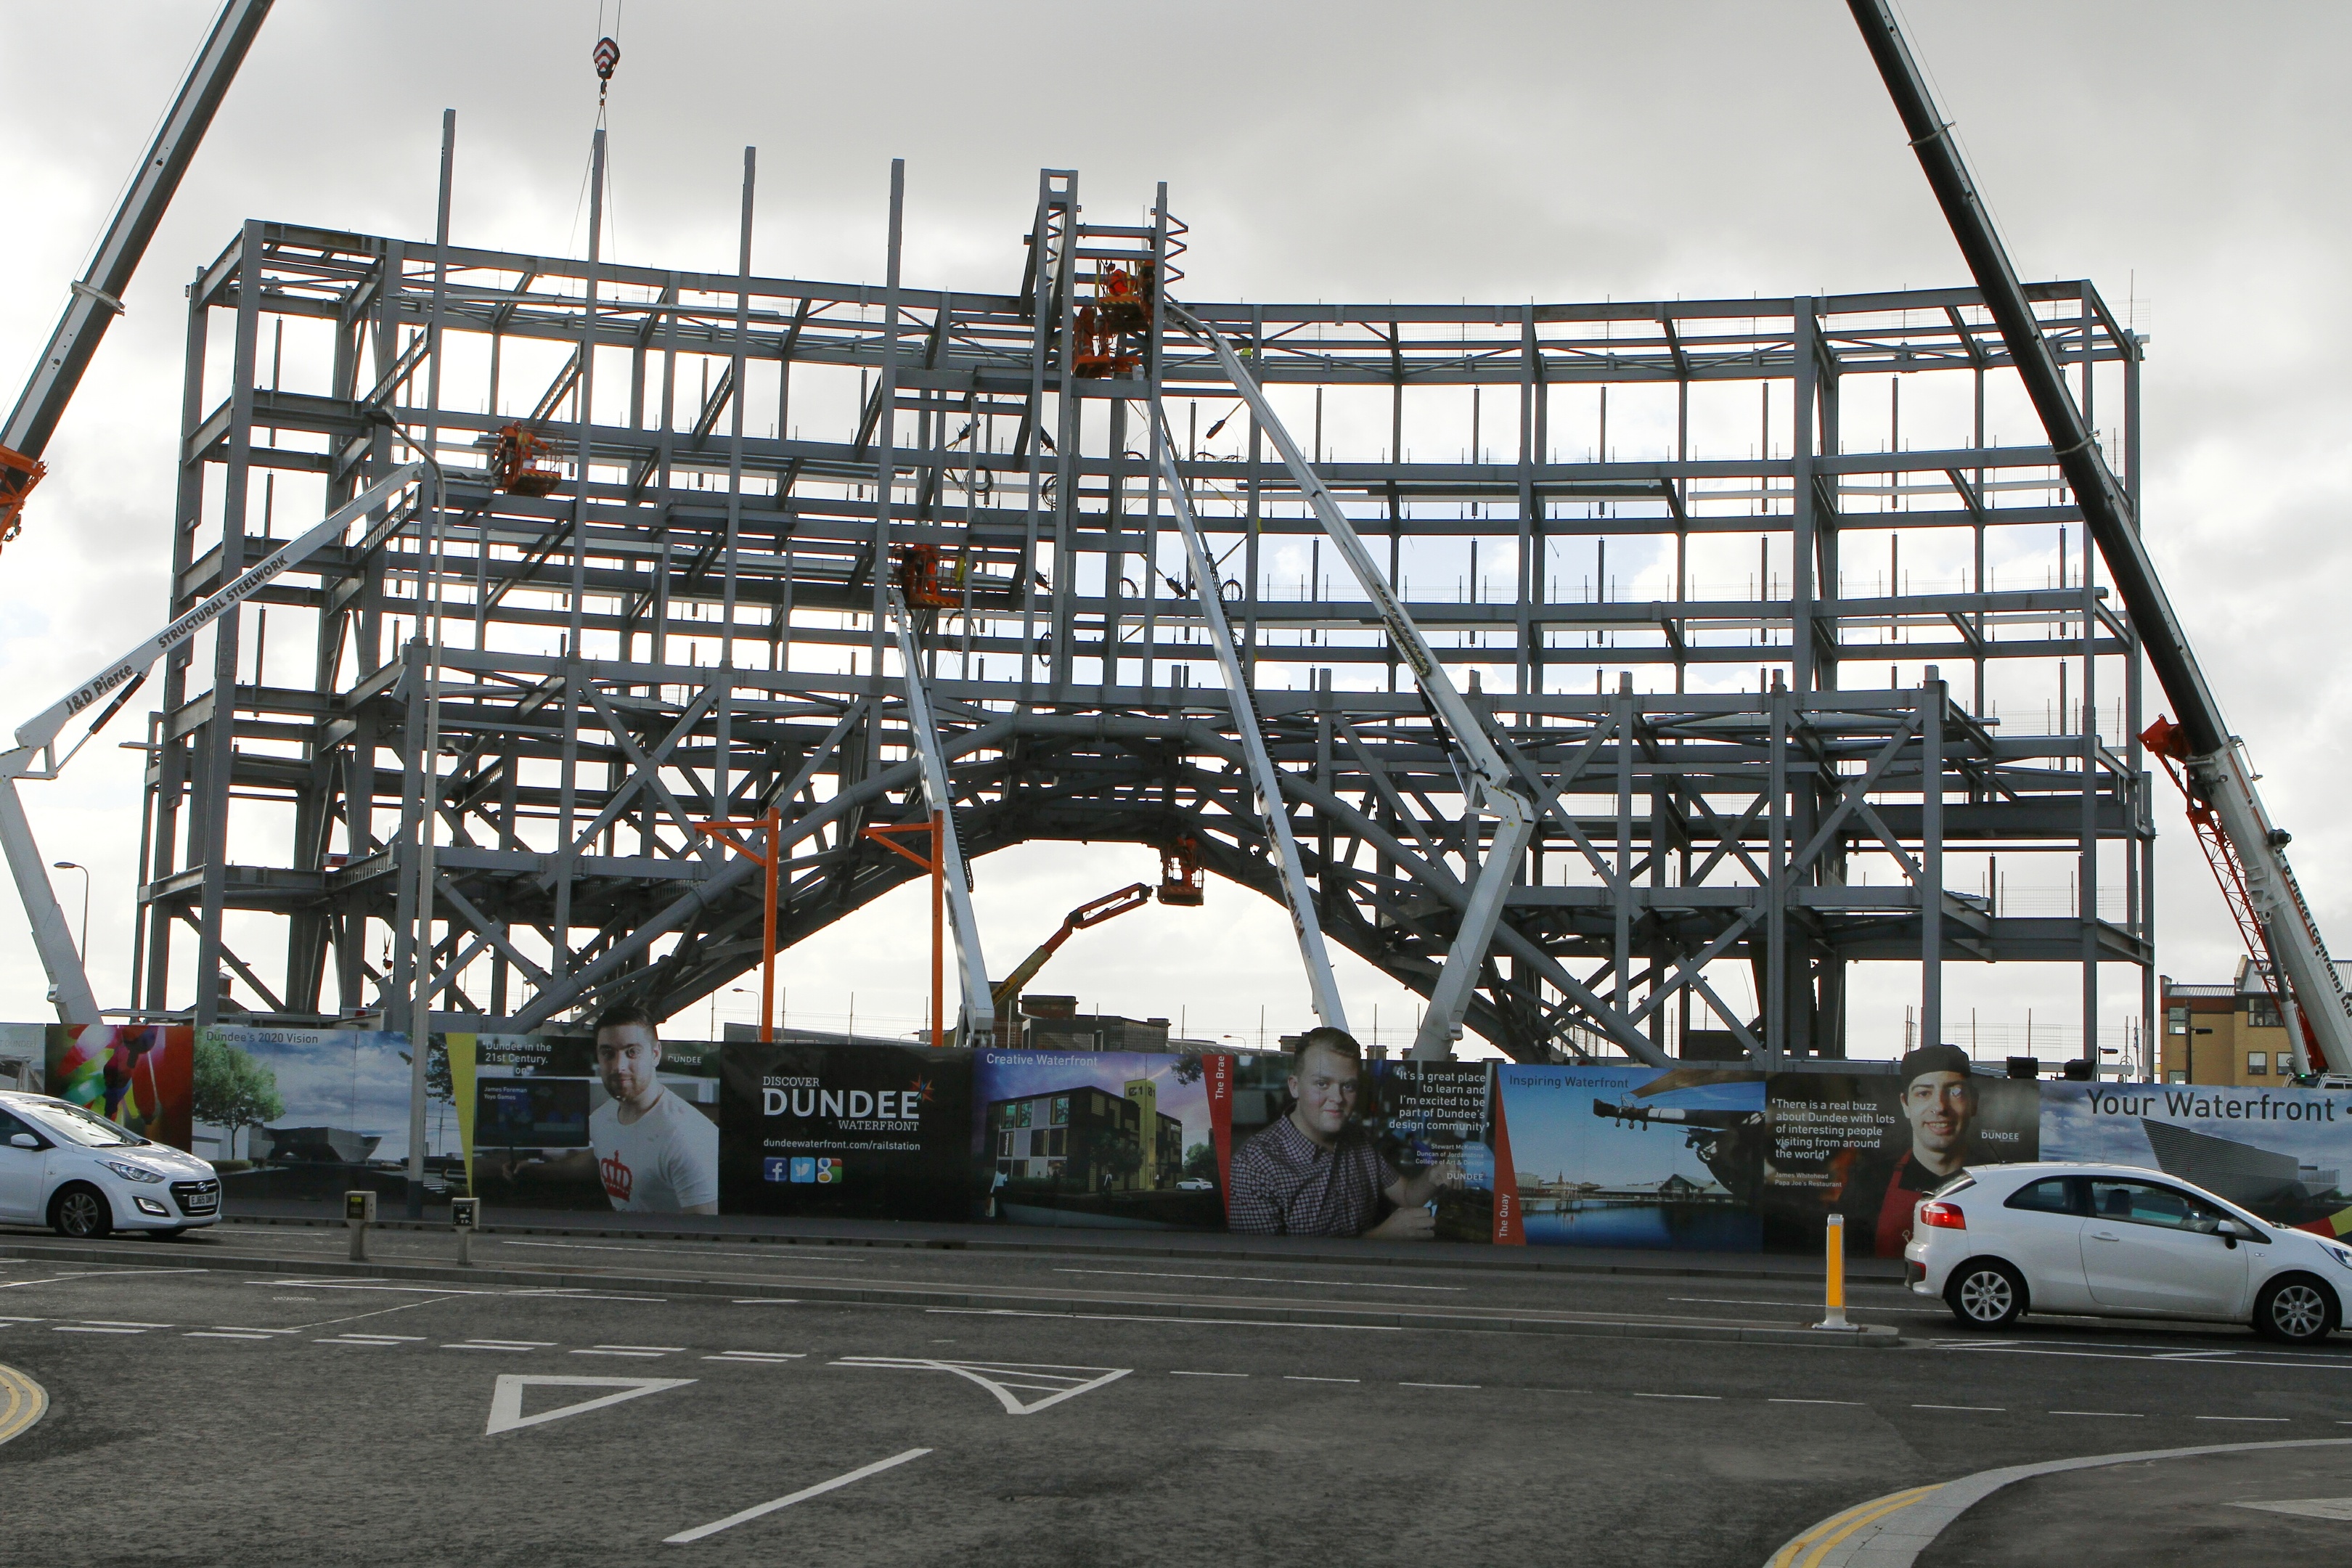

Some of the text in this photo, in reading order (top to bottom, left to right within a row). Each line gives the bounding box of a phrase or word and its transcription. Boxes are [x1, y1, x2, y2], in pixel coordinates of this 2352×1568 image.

[158, 555, 288, 648] STRUCTURAL STEELWORK
[65, 665, 133, 716] J&D Pierce
[2290, 878, 2311, 920] Pierce
[2309, 923, 2343, 994] (Contracts)
[206, 1031, 319, 1043] Dundee's 2020 Vision
[525, 1042, 534, 1051] in
[536, 1042, 552, 1052] the
[485, 1053, 548, 1066] 21st Century.
[987, 1053, 1098, 1066] Creative Waterfront
[763, 1077, 820, 1087] DISCOVER
[1215, 1055, 1225, 1100] The Brae
[1427, 1072, 1455, 1083] great
[1458, 1072, 1486, 1084] place
[1509, 1075, 1628, 1089] Inspiring Waterfront
[1423, 1084, 1433, 1093] to
[1436, 1084, 1463, 1094] learn
[762, 1088, 920, 1119] DUNDEE
[1400, 1095, 1485, 1107] I'm excited to be
[1809, 1100, 1818, 1109] is
[1829, 1101, 1850, 1110] real
[1853, 1101, 1877, 1111] buzz
[2086, 1089, 2335, 1122] Your Waterfront
[1399, 1108, 1485, 1119] part of Dundee's
[1776, 1111, 1895, 1124] about Dundee with lots
[838, 1120, 920, 1132] WATERFRONT
[1389, 1119, 1424, 1132] design
[1776, 1124, 1882, 1138] of interesting people
[763, 1138, 921, 1151] dundeewaterfront.com/railstation
[1776, 1136, 1880, 1149] visiting from around
[1776, 1149, 1792, 1159] the
[1499, 1193, 1511, 1238] The Quay
